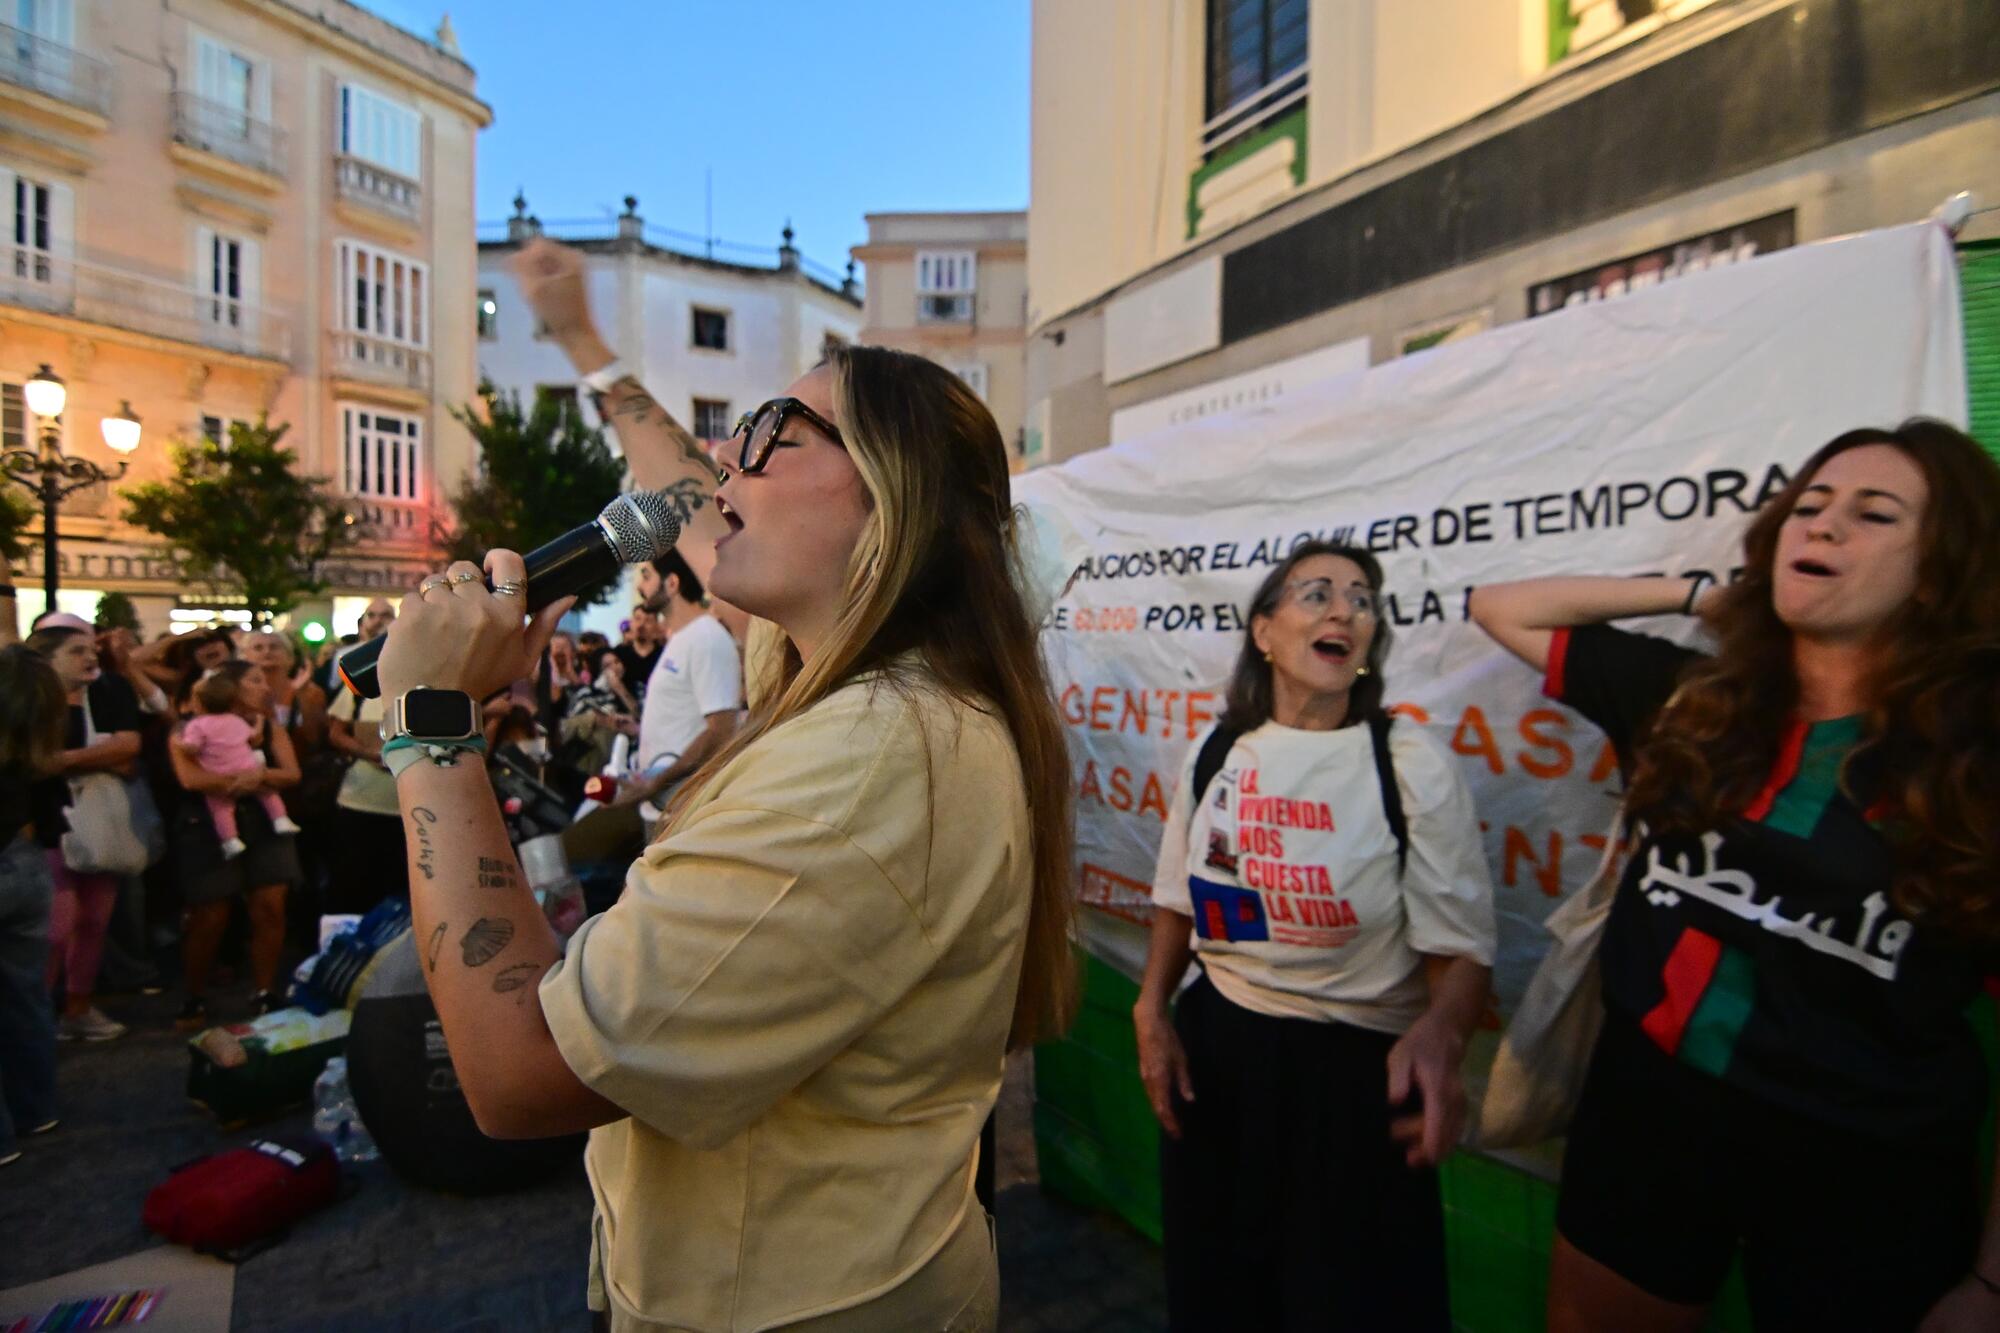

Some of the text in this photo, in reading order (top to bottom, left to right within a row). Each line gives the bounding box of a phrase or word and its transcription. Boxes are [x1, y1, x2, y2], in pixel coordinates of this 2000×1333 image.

[1158, 546, 1207, 576] POR
[1210, 541, 1242, 571] EL
[1432, 503, 1493, 547] DE
[1145, 604, 1206, 631] POR
[1240, 768, 1259, 795] LA
[1238, 796, 1337, 833] VIVIENDA
[1238, 825, 1285, 859] NOS
[1245, 857, 1336, 897] CUESTA
[1265, 893, 1360, 929] LA VIDA
